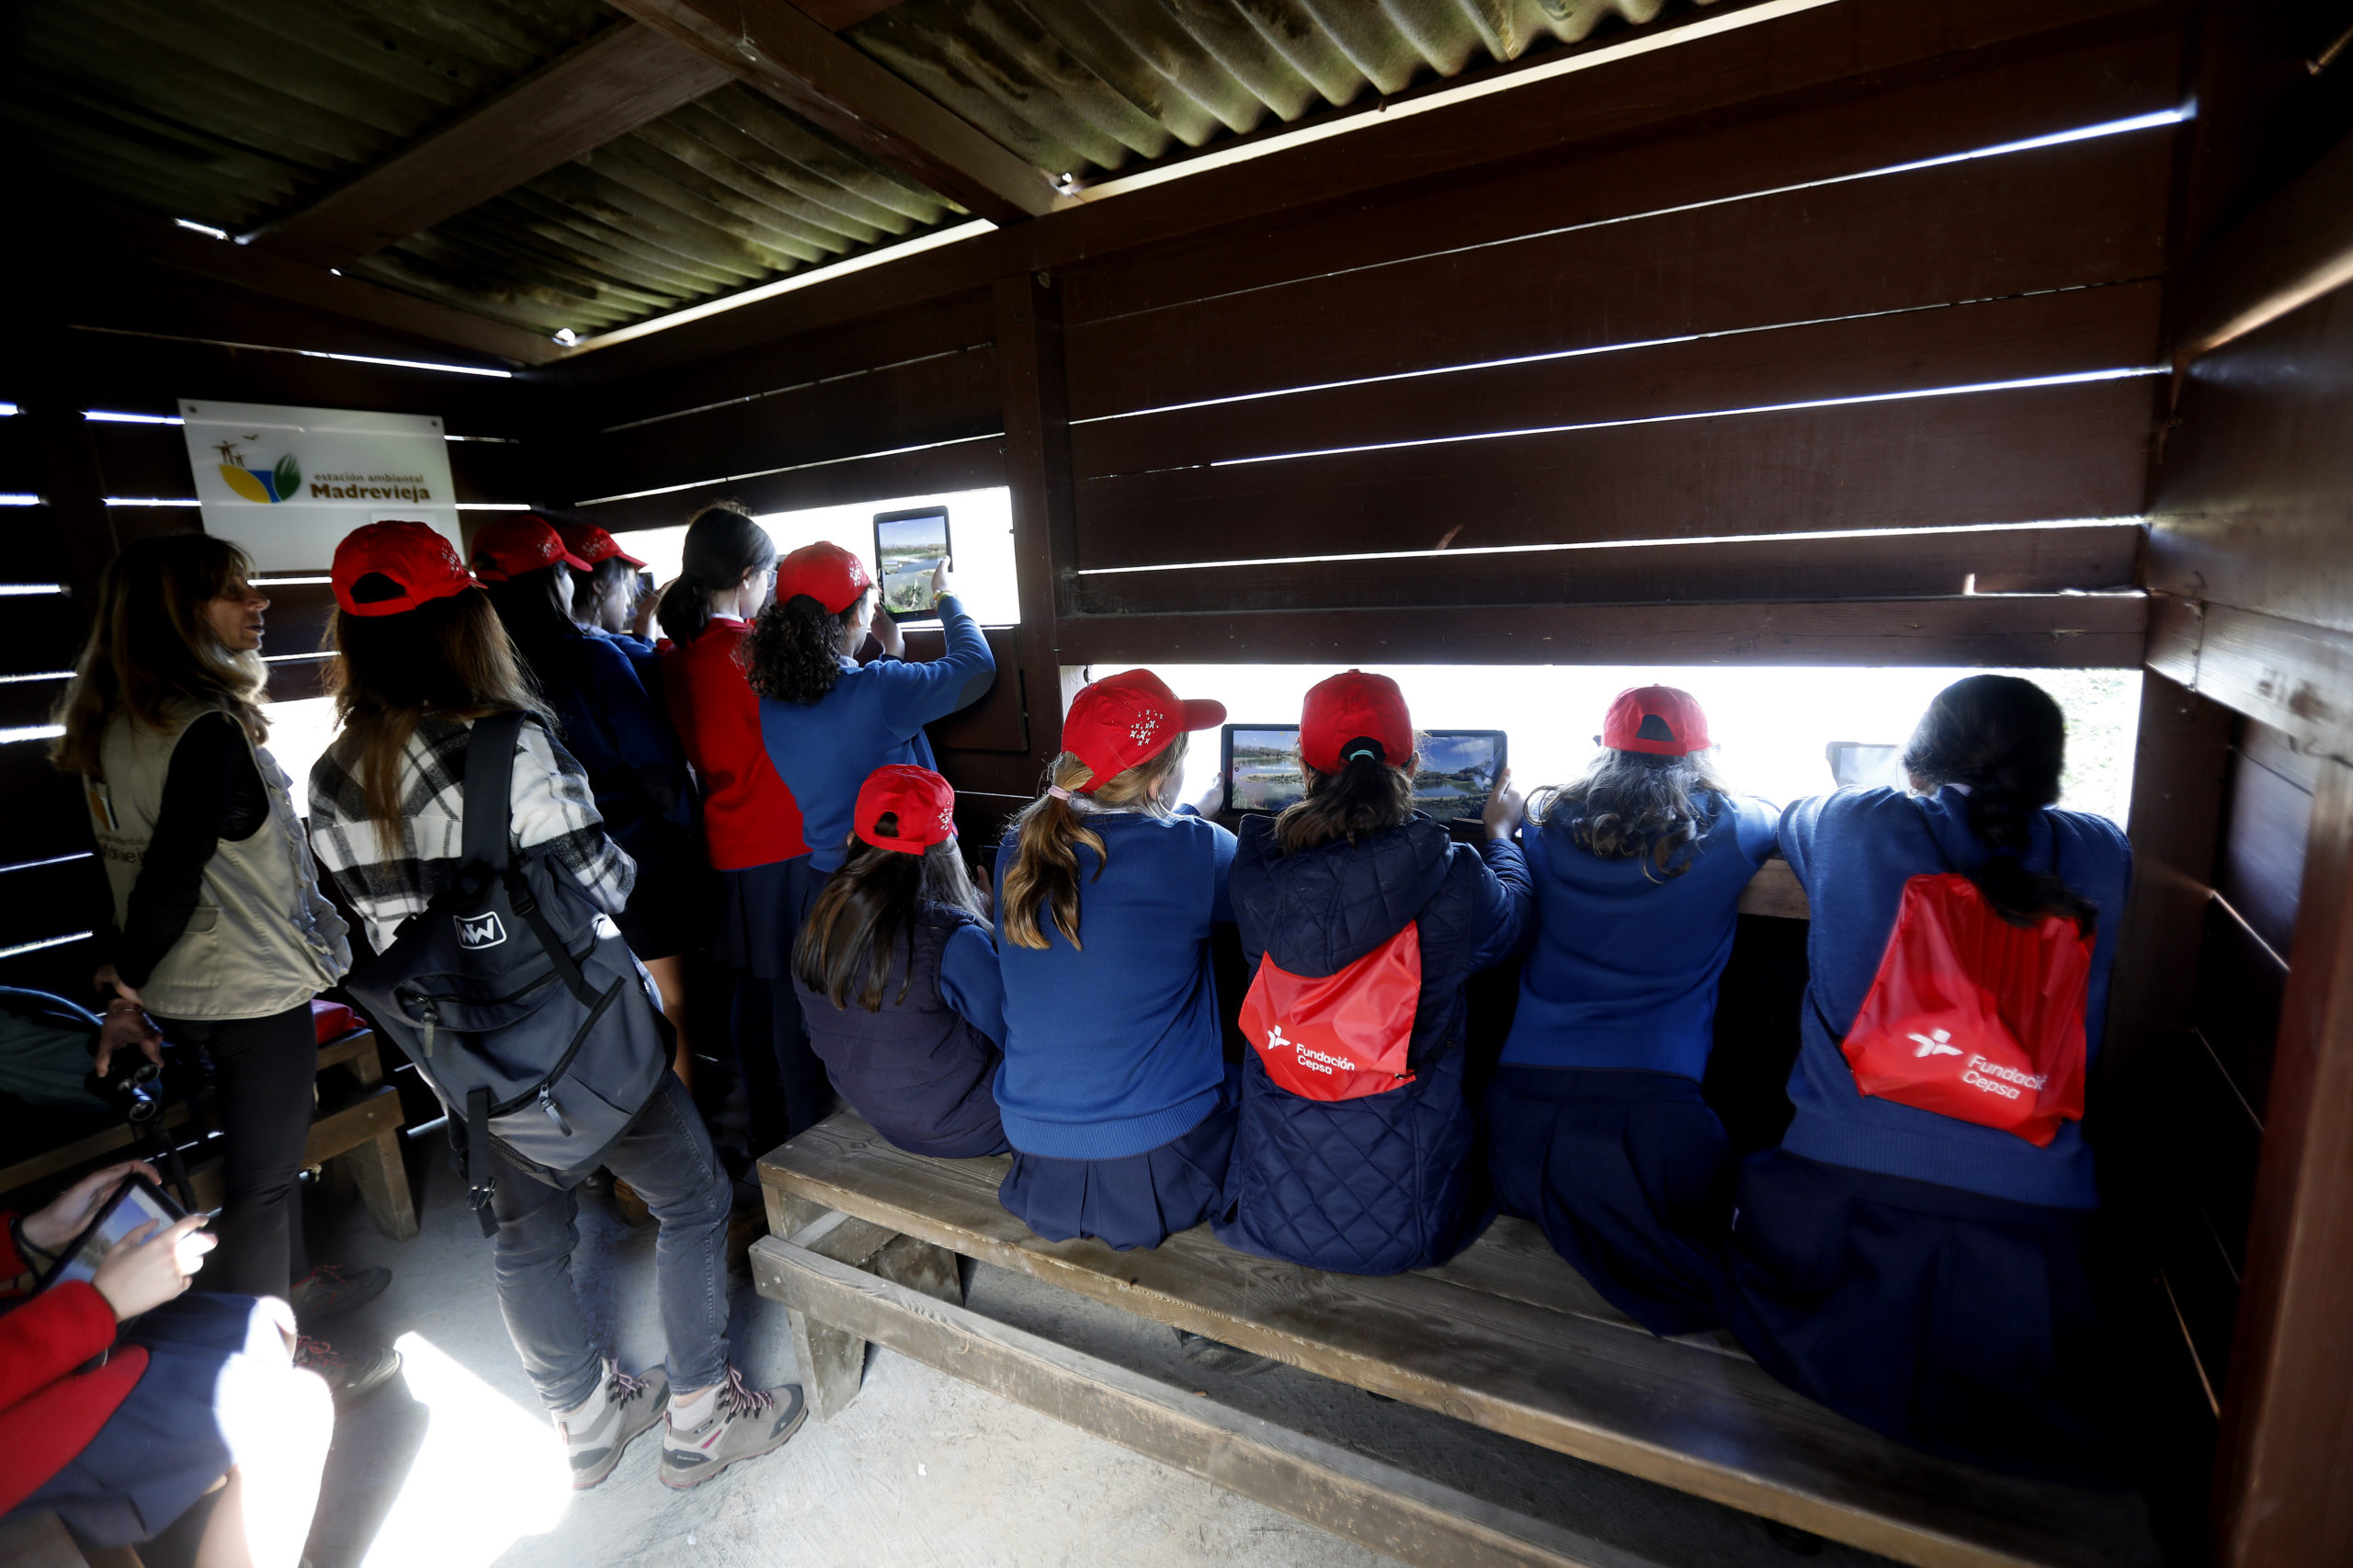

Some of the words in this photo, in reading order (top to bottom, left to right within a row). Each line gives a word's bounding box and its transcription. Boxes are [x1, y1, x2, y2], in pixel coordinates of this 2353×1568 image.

[314, 472, 364, 483] estación
[368, 472, 424, 483] ambiental
[310, 483, 431, 503] Madrevieja
[1296, 1042, 1356, 1072] Fundación
[1297, 1056, 1333, 1075] Cepsa
[1962, 1071, 2021, 1100] Cepsa
